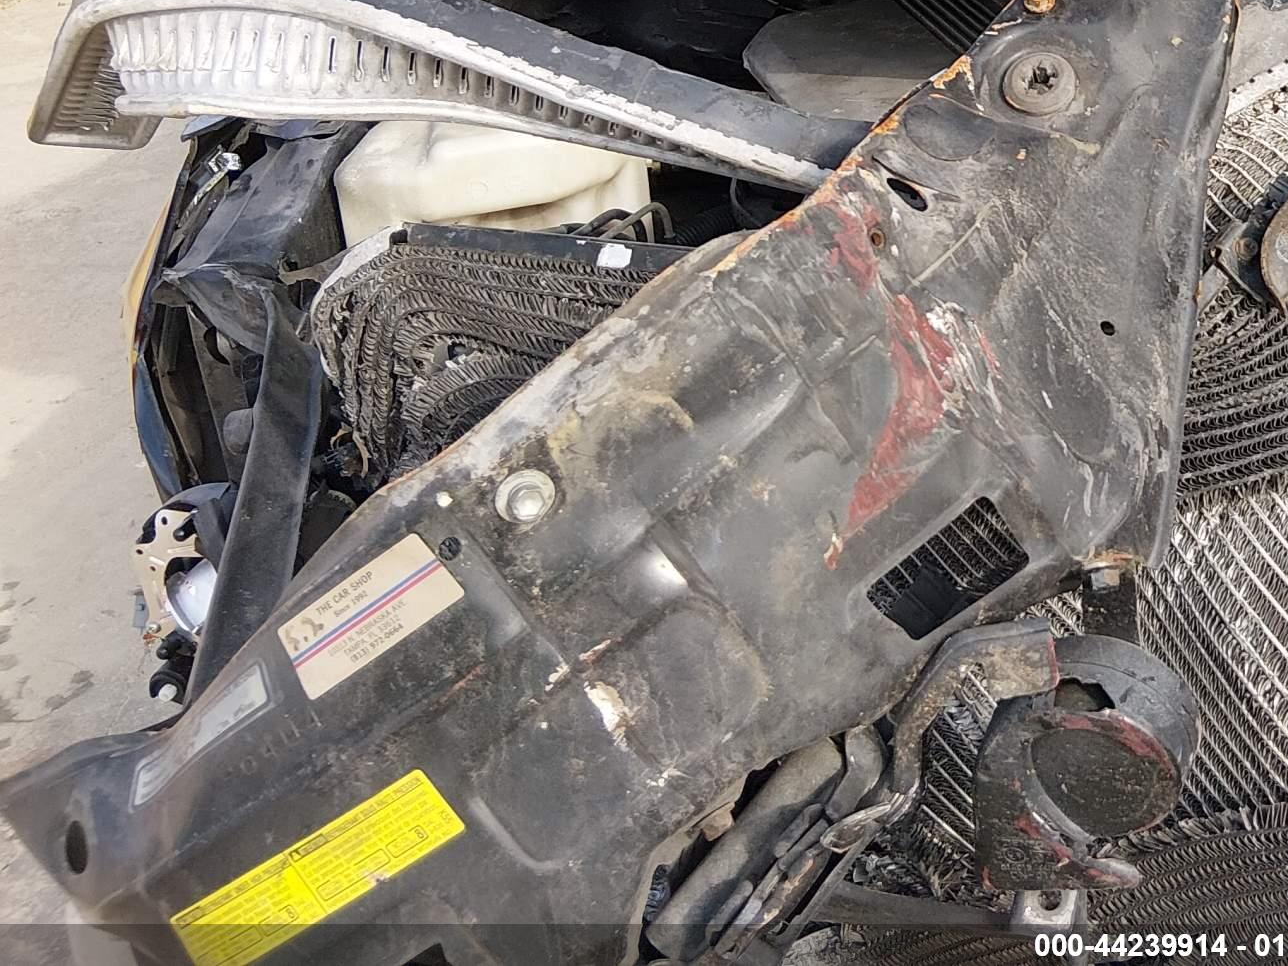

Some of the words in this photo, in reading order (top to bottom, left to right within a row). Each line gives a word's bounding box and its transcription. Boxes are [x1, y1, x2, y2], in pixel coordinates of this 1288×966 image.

[315, 599, 333, 616] THE
[331, 586, 350, 604] CAR
[349, 569, 374, 591] SHOP
[350, 589, 368, 605] 1992
[354, 608, 391, 638] NEBRASKA
